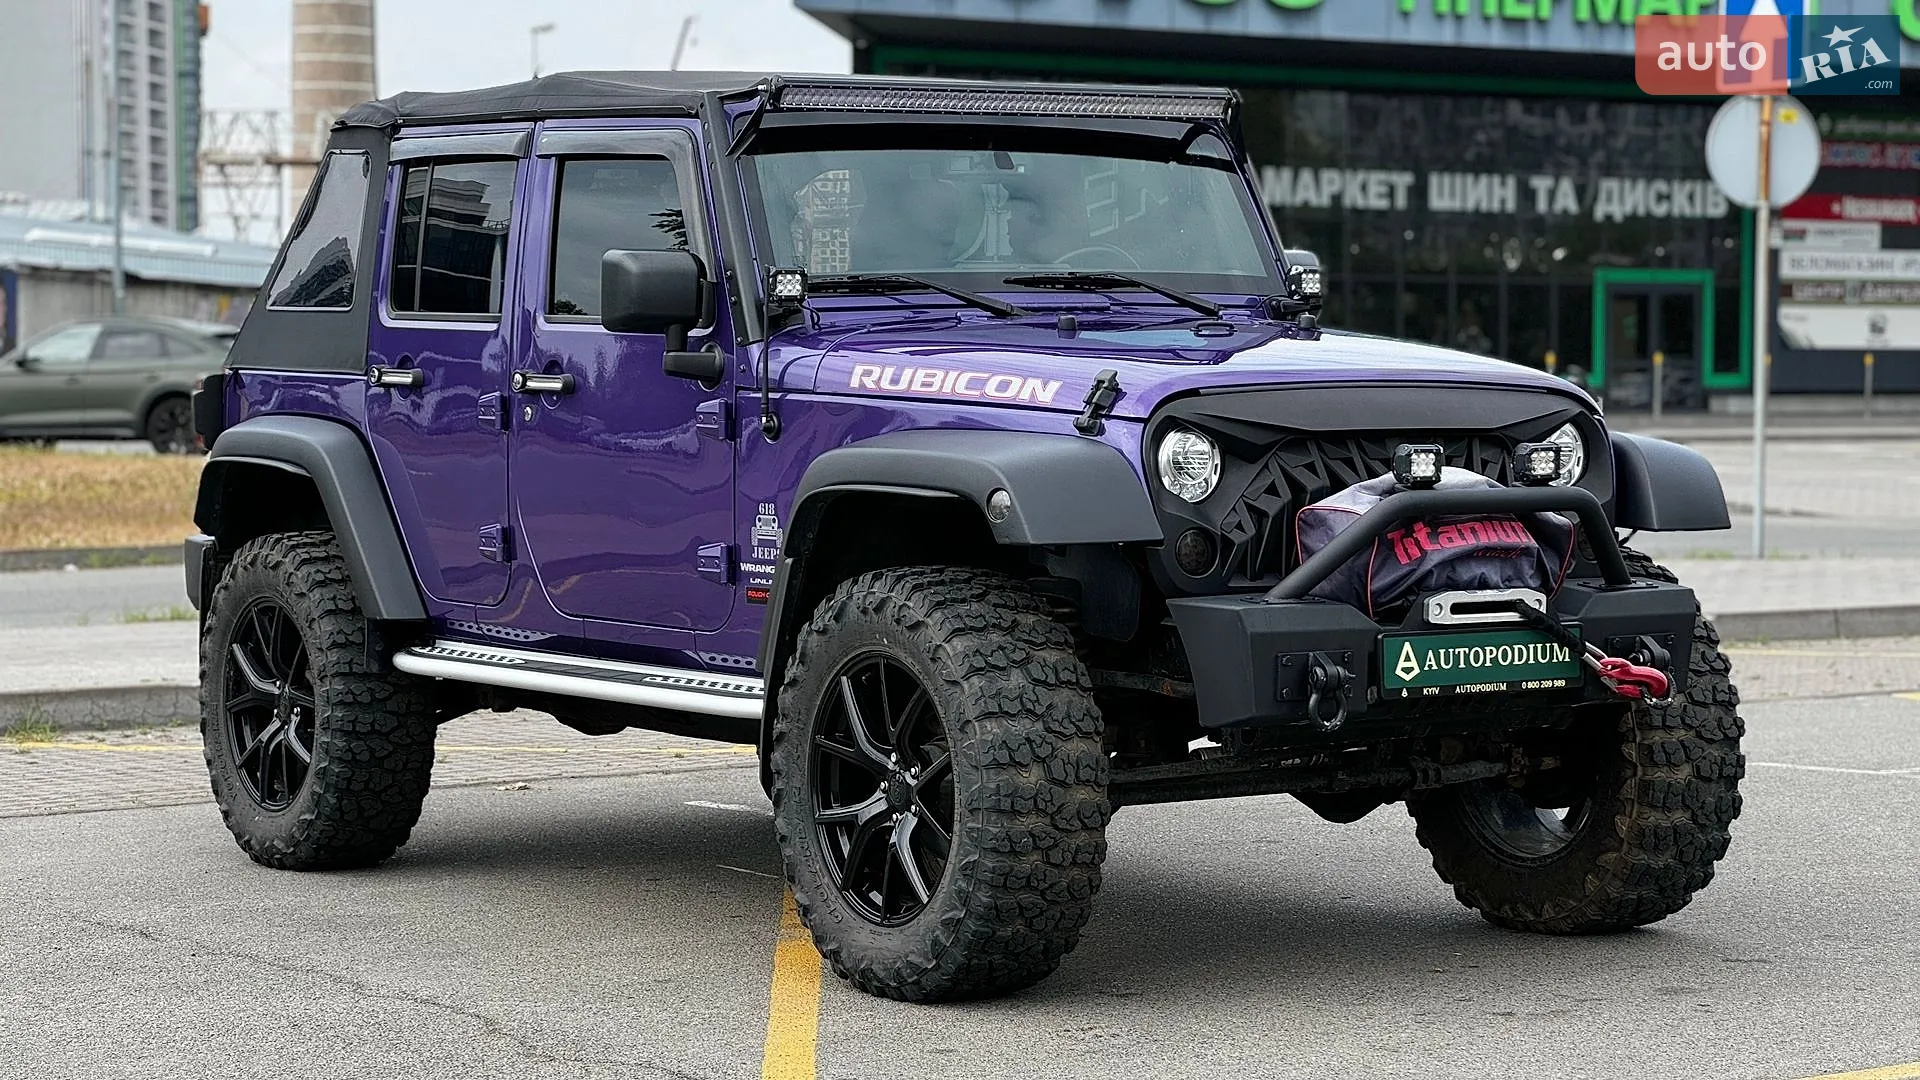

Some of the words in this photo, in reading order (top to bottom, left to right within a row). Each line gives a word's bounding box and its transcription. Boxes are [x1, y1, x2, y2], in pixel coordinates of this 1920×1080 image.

[1261, 165, 1415, 211] МАРКЕТ
[1427, 171, 1517, 214] ШИН
[1529, 174, 1580, 215] ТА
[1593, 176, 1729, 223] ДИСКІВ
[850, 363, 1063, 405] RUBICON
[758, 502, 775, 515] 618
[1423, 642, 1571, 671] AUTOPODIUM
[1422, 686, 1440, 696] KYIV
[1454, 682, 1507, 694] AUTOPODIUM
[1527, 680, 1540, 689] 800
[1540, 679, 1553, 688] 209
